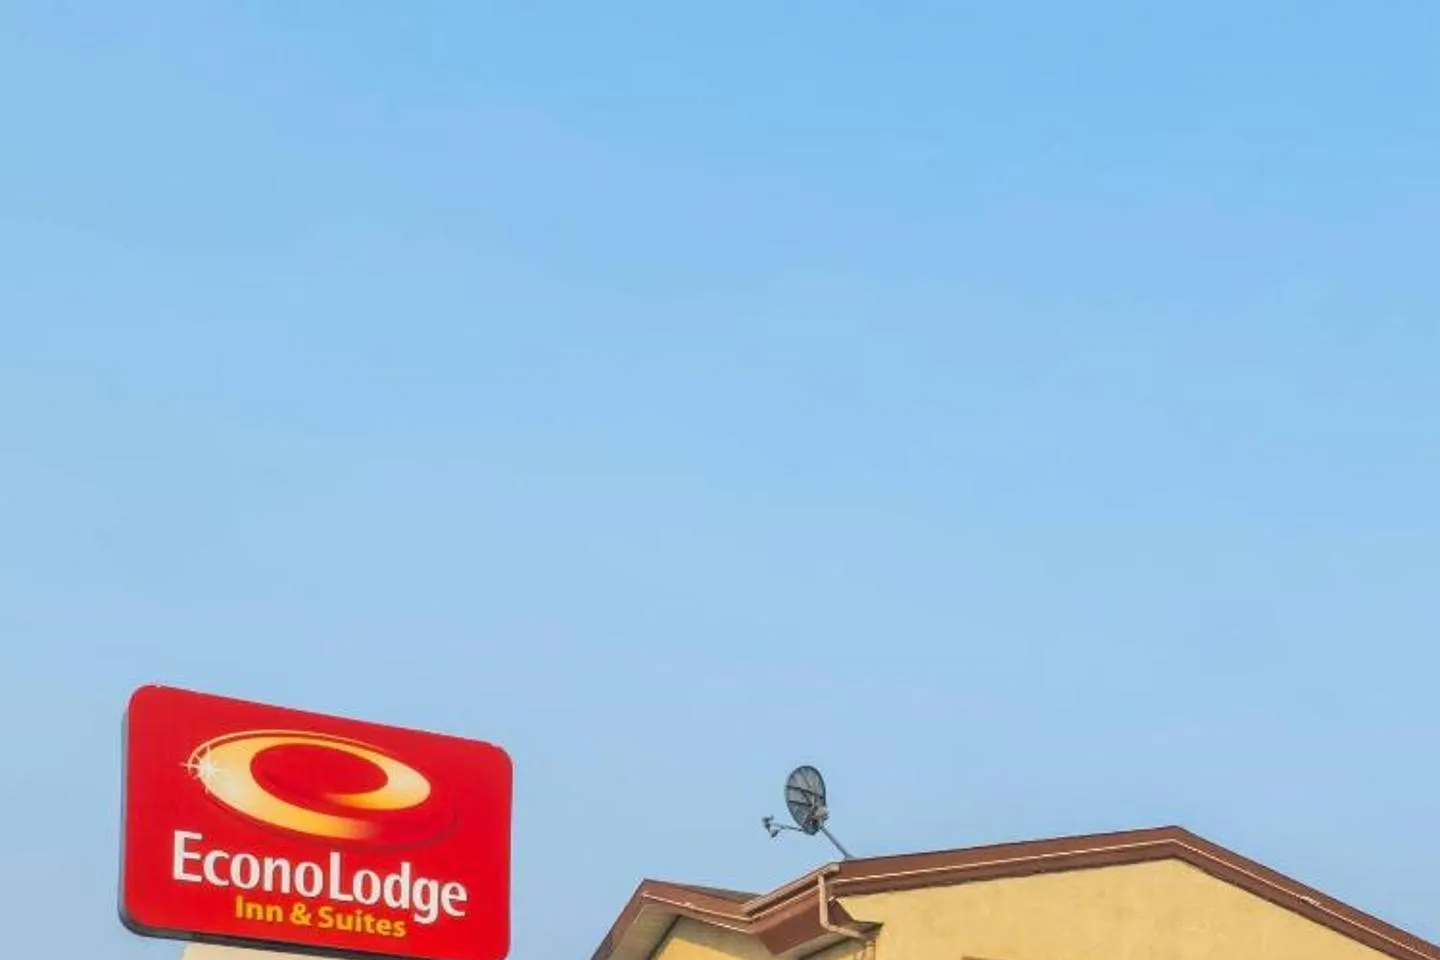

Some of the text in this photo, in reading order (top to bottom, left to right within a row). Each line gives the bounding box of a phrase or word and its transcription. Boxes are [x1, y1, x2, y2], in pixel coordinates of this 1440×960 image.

[173, 829, 468, 924] EconoLodge
[235, 895, 407, 938] Inn & Suites
